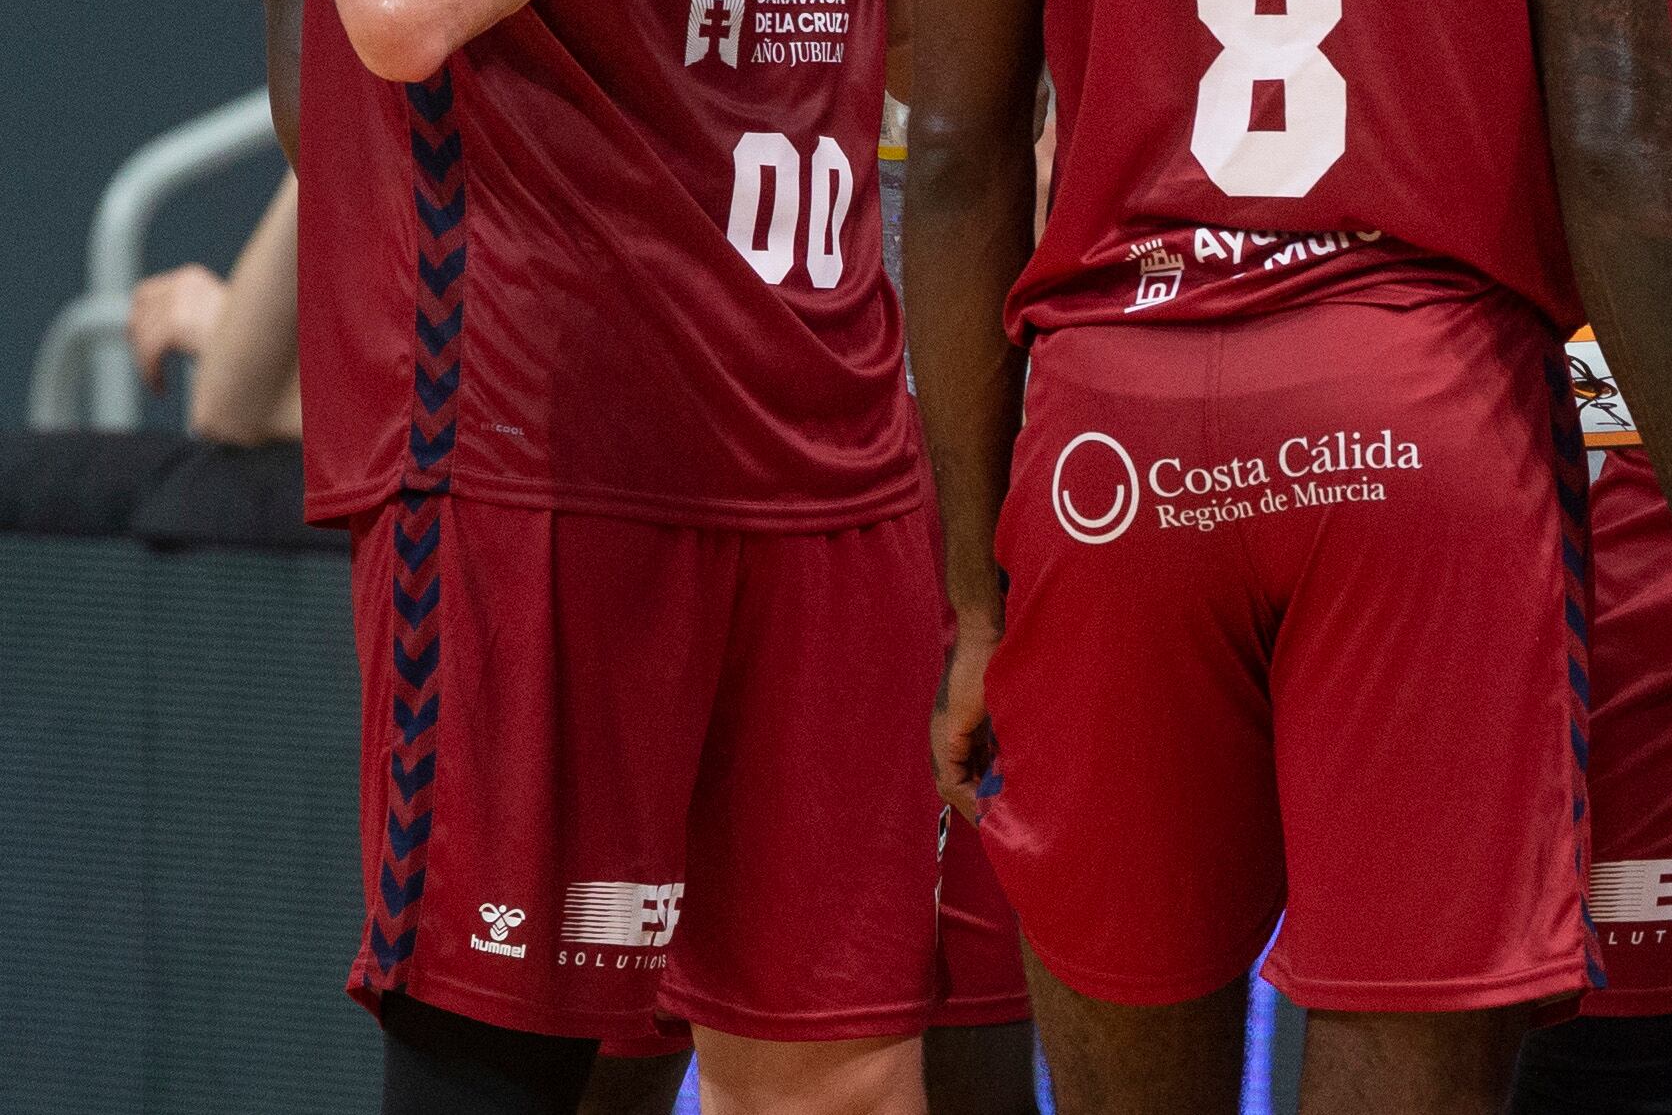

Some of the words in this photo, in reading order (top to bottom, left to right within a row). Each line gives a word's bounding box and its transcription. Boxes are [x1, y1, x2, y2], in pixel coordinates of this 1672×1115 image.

[755, 13, 772, 33] DE
[775, 13, 795, 33] LA
[798, 12, 843, 33] CRUZ
[751, 38, 785, 64] AÑO
[790, 42, 845, 67] JUBILA
[727, 132, 853, 289] 00
[1148, 456, 1270, 498] Costa
[1278, 430, 1423, 478] Cálida
[1156, 496, 1256, 532] Región
[1260, 488, 1289, 514] de
[1293, 476, 1387, 509] Murcia
[470, 934, 526, 959] hummel
